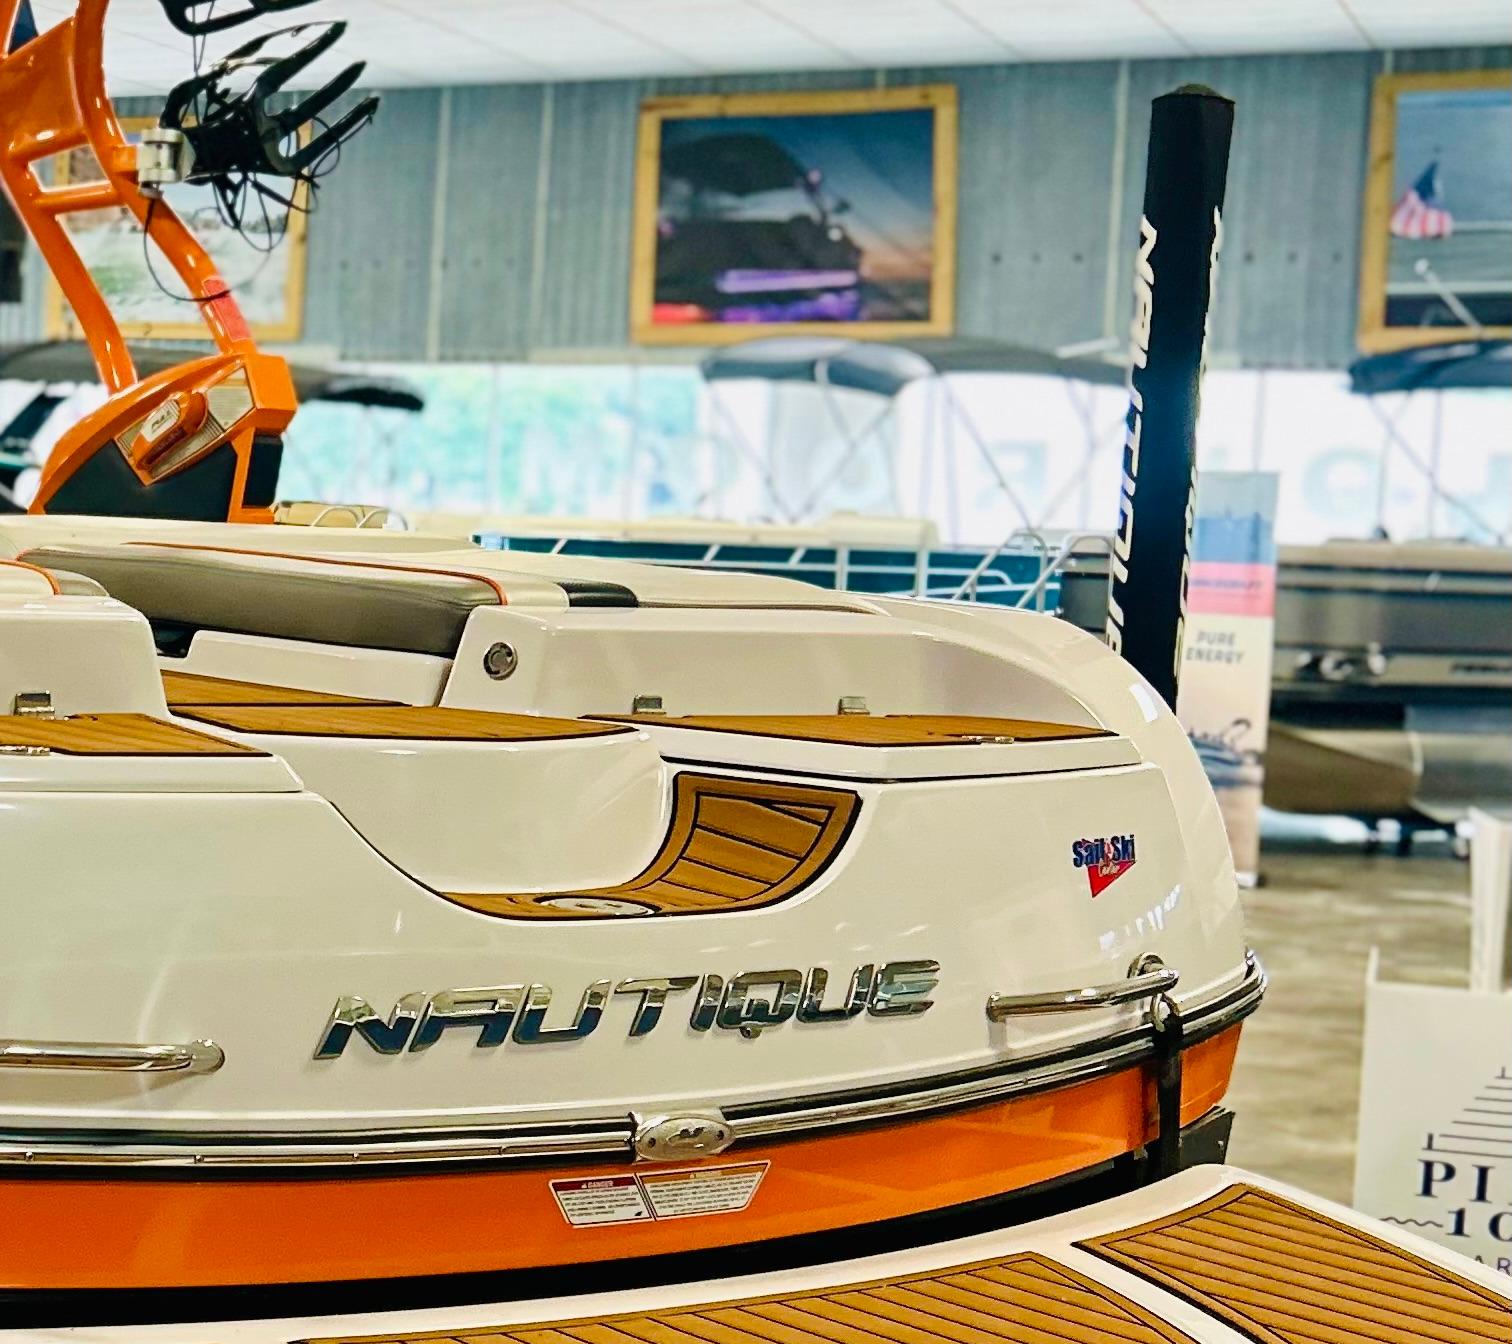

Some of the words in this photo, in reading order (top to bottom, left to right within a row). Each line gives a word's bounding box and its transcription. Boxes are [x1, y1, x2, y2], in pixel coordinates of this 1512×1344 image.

[1196, 630, 1237, 646] PURE
[1185, 644, 1246, 664] ENERGY
[313, 959, 943, 1060] NAUTIQUE
